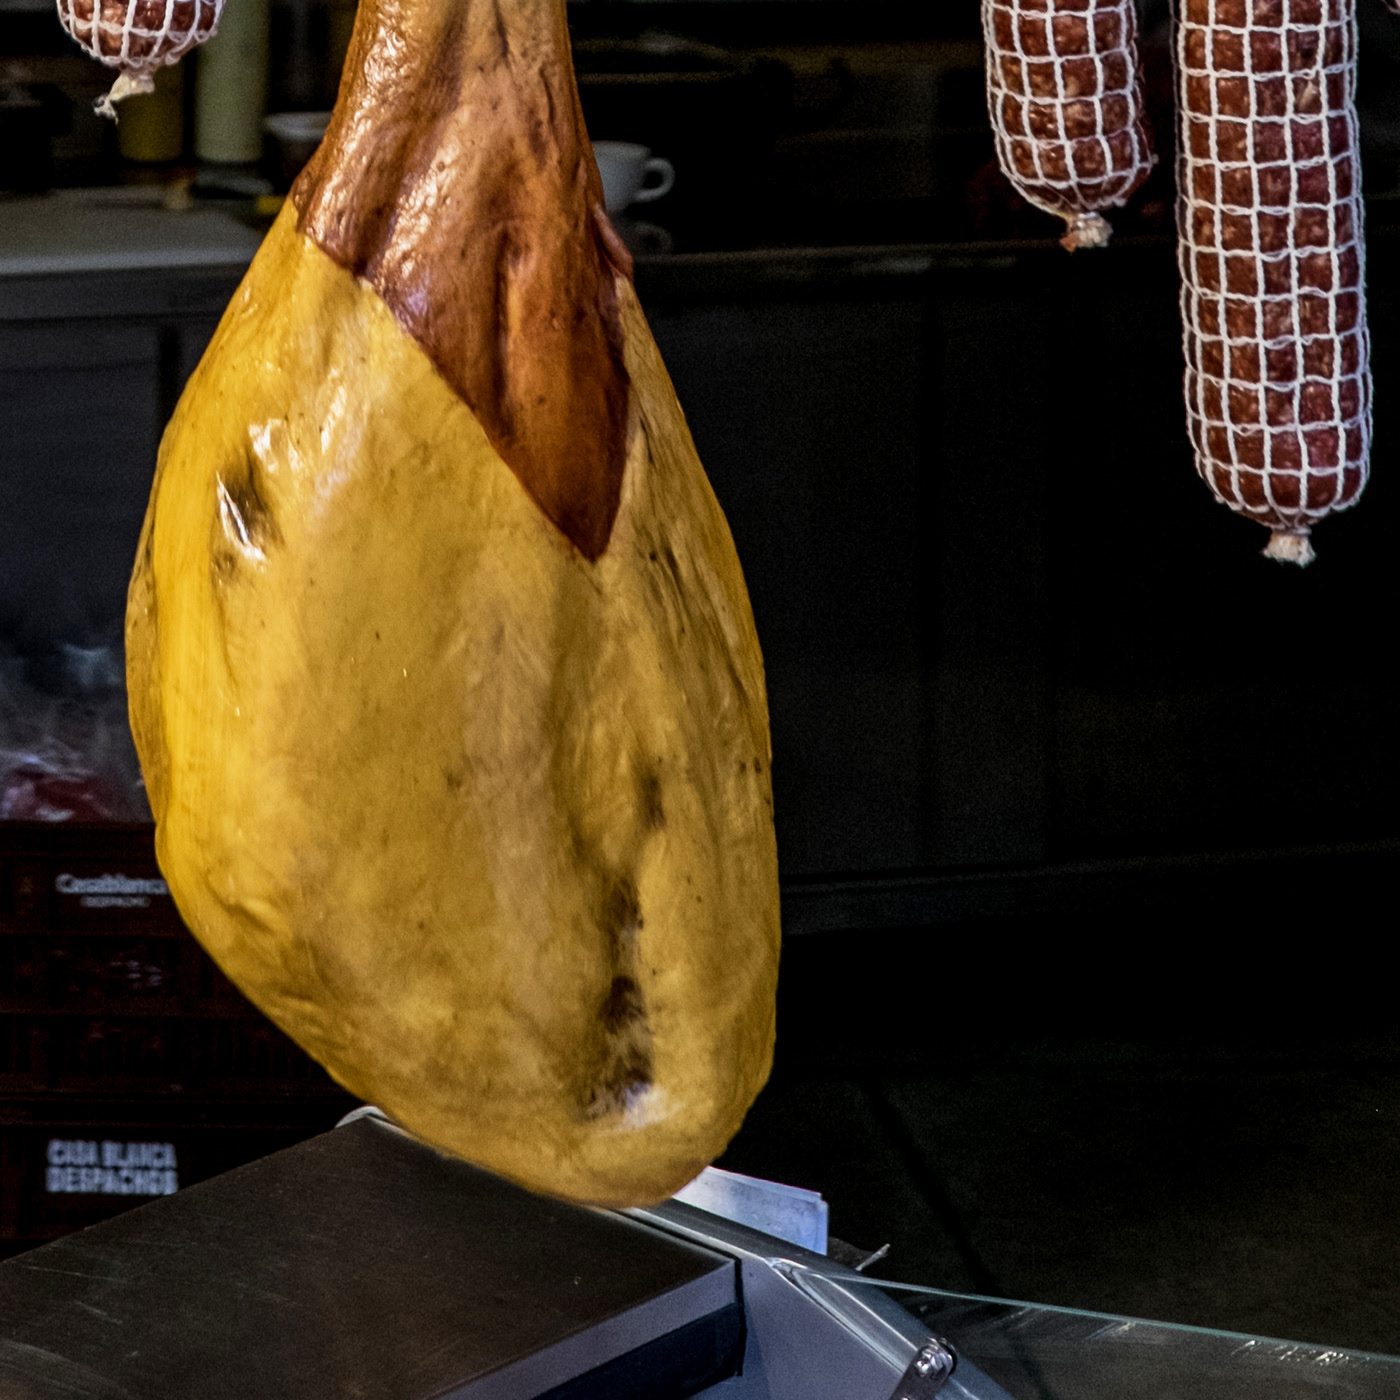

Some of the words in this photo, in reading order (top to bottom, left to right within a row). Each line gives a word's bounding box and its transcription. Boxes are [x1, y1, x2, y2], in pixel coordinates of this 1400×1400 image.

[47, 1139, 98, 1165] CASA
[101, 1141, 177, 1168] BLANCA
[45, 1167, 178, 1196] DESPACHOS
